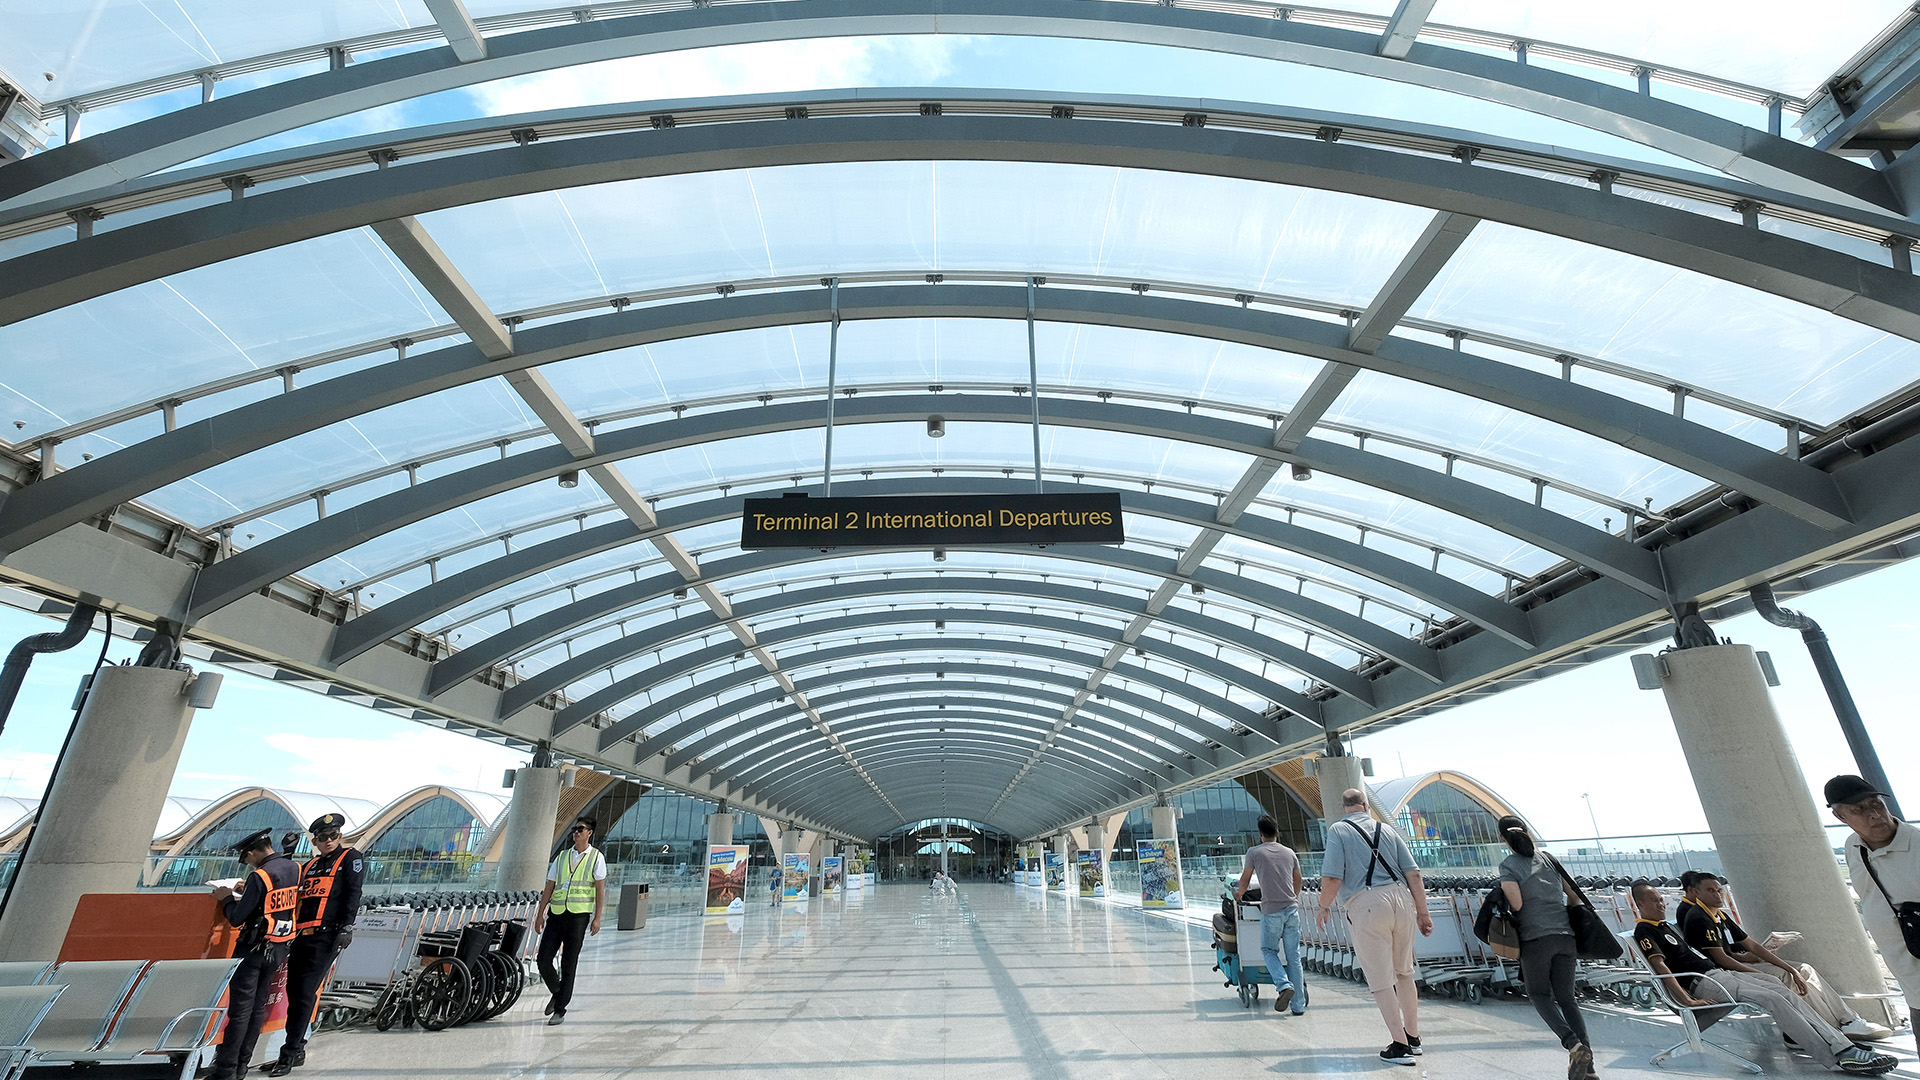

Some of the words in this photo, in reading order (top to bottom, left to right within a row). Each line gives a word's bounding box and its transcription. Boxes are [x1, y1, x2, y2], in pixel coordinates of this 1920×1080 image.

[753, 512, 839, 531] Terminal
[845, 511, 859, 530] 2
[866, 509, 993, 529] International
[999, 509, 1113, 530] Departures
[1217, 836, 1224, 845] 1
[662, 844, 670, 854] 2
[1640, 938, 1652, 951] 03
